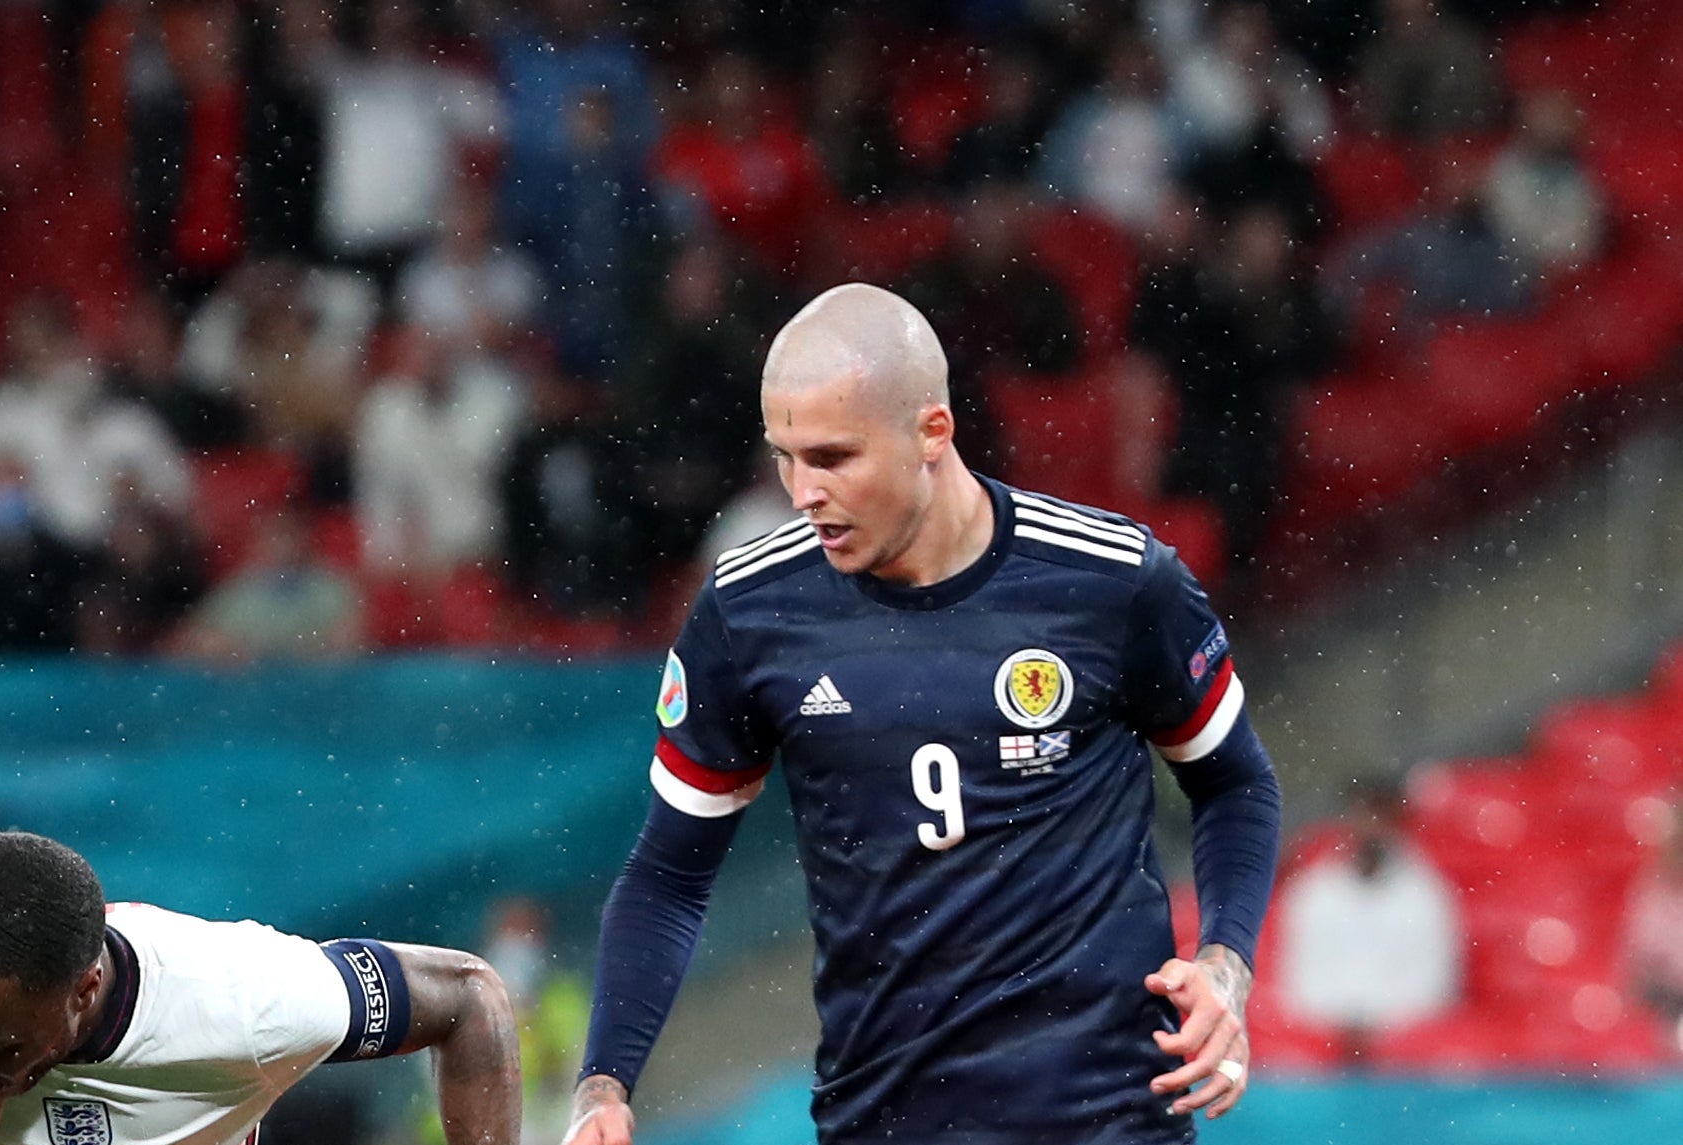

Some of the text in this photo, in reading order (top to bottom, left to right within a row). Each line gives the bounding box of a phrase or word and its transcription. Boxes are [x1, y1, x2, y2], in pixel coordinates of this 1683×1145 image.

[799, 701, 852, 716] adidas
[911, 742, 966, 851] 9
[348, 951, 385, 1034] RESPECT
